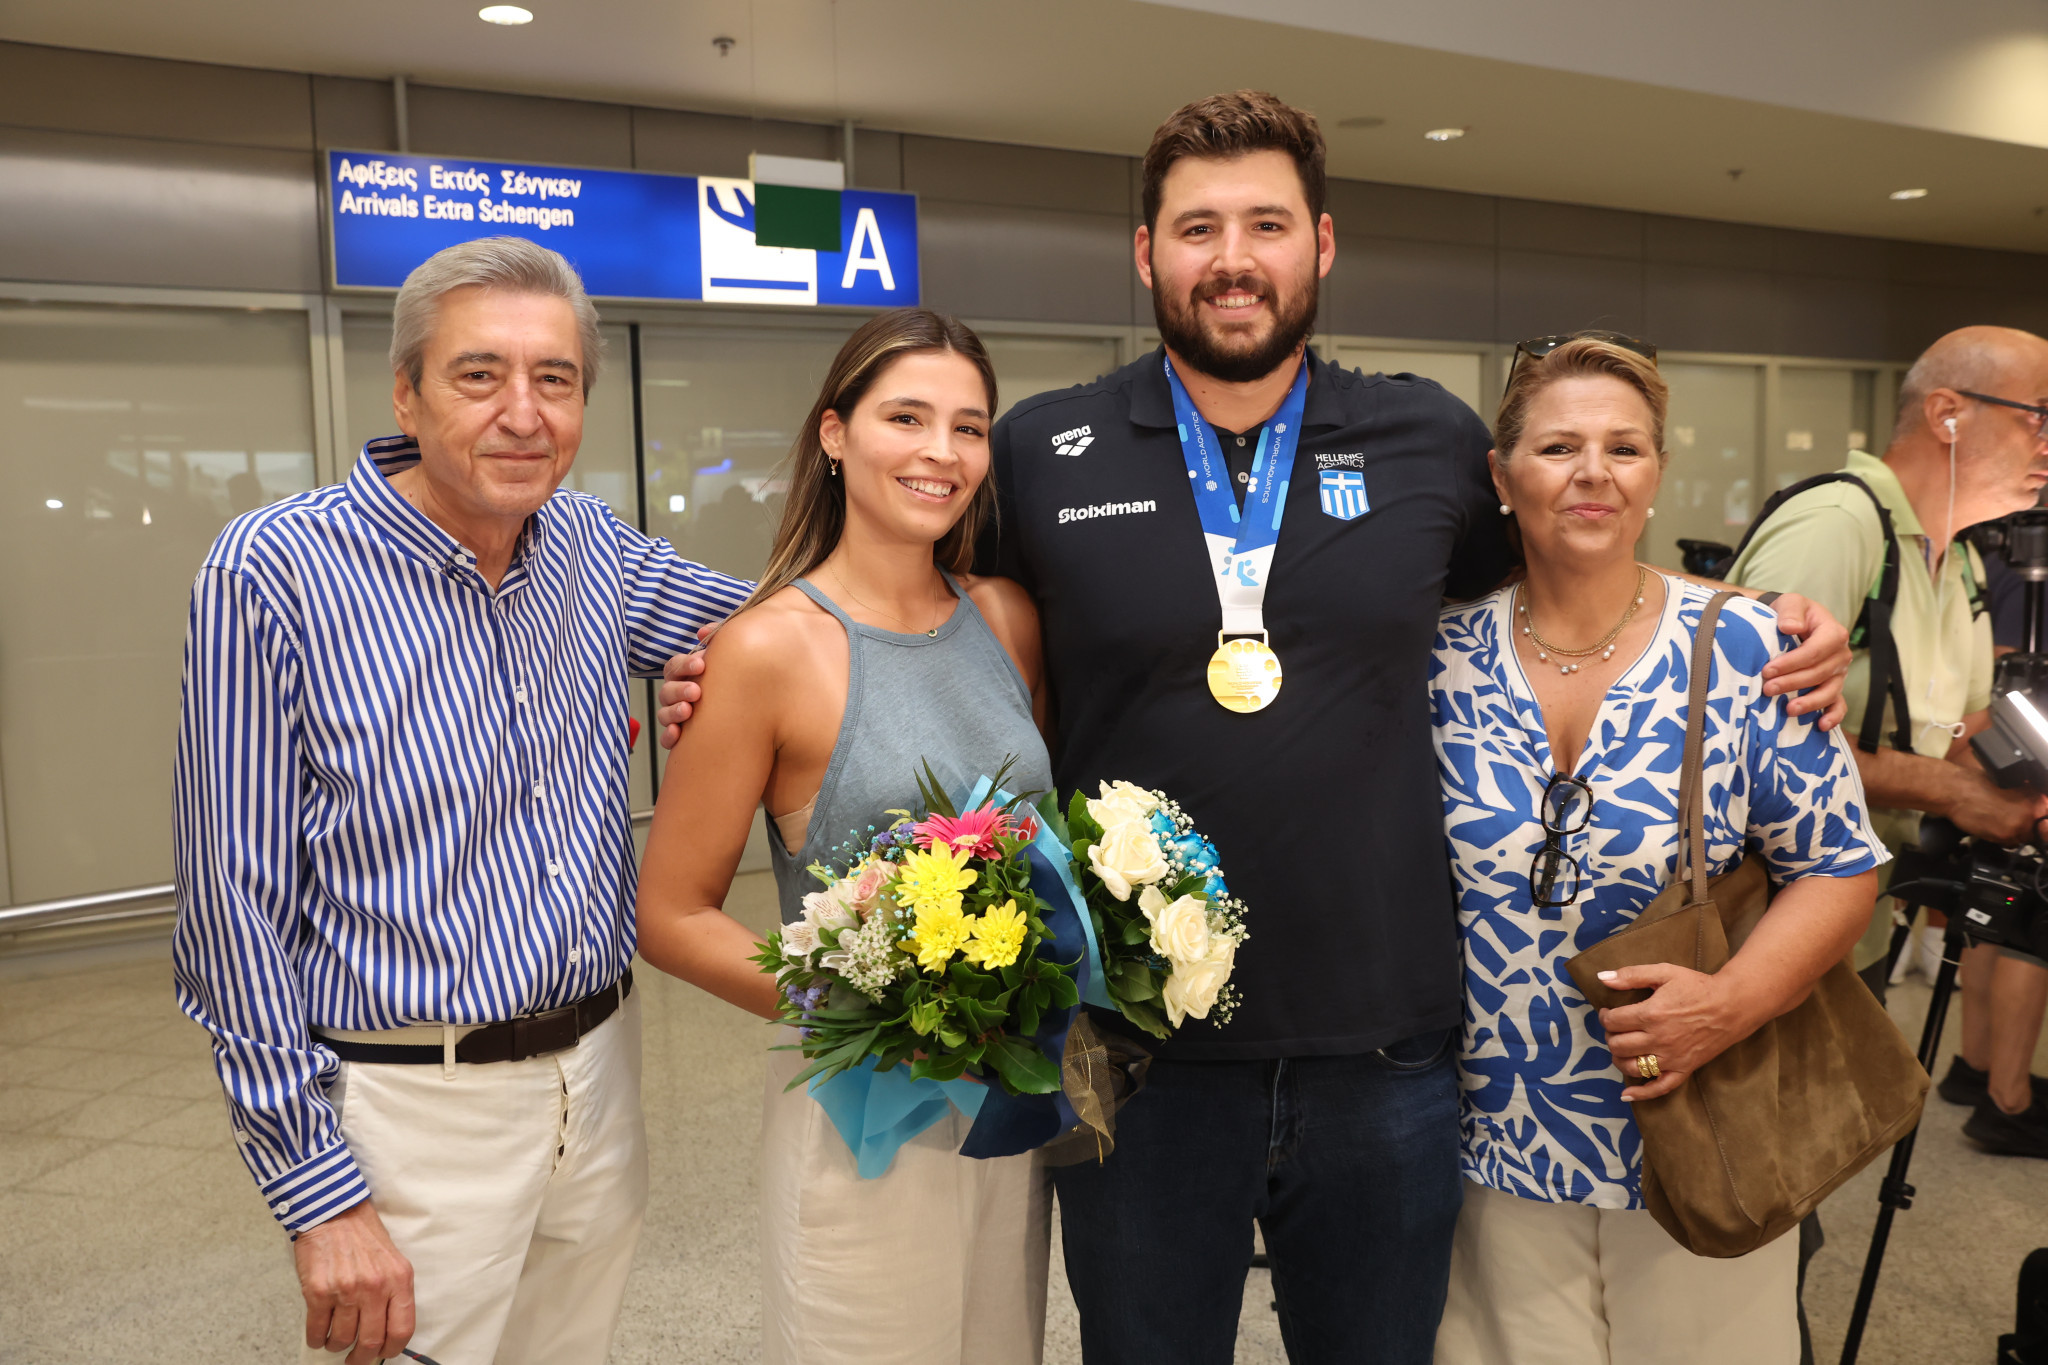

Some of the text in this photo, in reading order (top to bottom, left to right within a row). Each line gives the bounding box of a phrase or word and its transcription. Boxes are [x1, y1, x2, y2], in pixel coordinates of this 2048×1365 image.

[338, 158, 582, 201] Αφίξεις Εκτός Σένγκεν
[339, 189, 574, 230] Arrivals Extra Schengen
[841, 207, 896, 291] A
[1051, 424, 1092, 447] arena
[1191, 411, 1212, 478] WORLD AQUATICS
[1261, 436, 1282, 504] WORLD AQUATICS
[1314, 452, 1364, 462] HELLENIC
[1317, 458, 1365, 470] AQUATICS
[1058, 499, 1157, 524] Stoiximan
